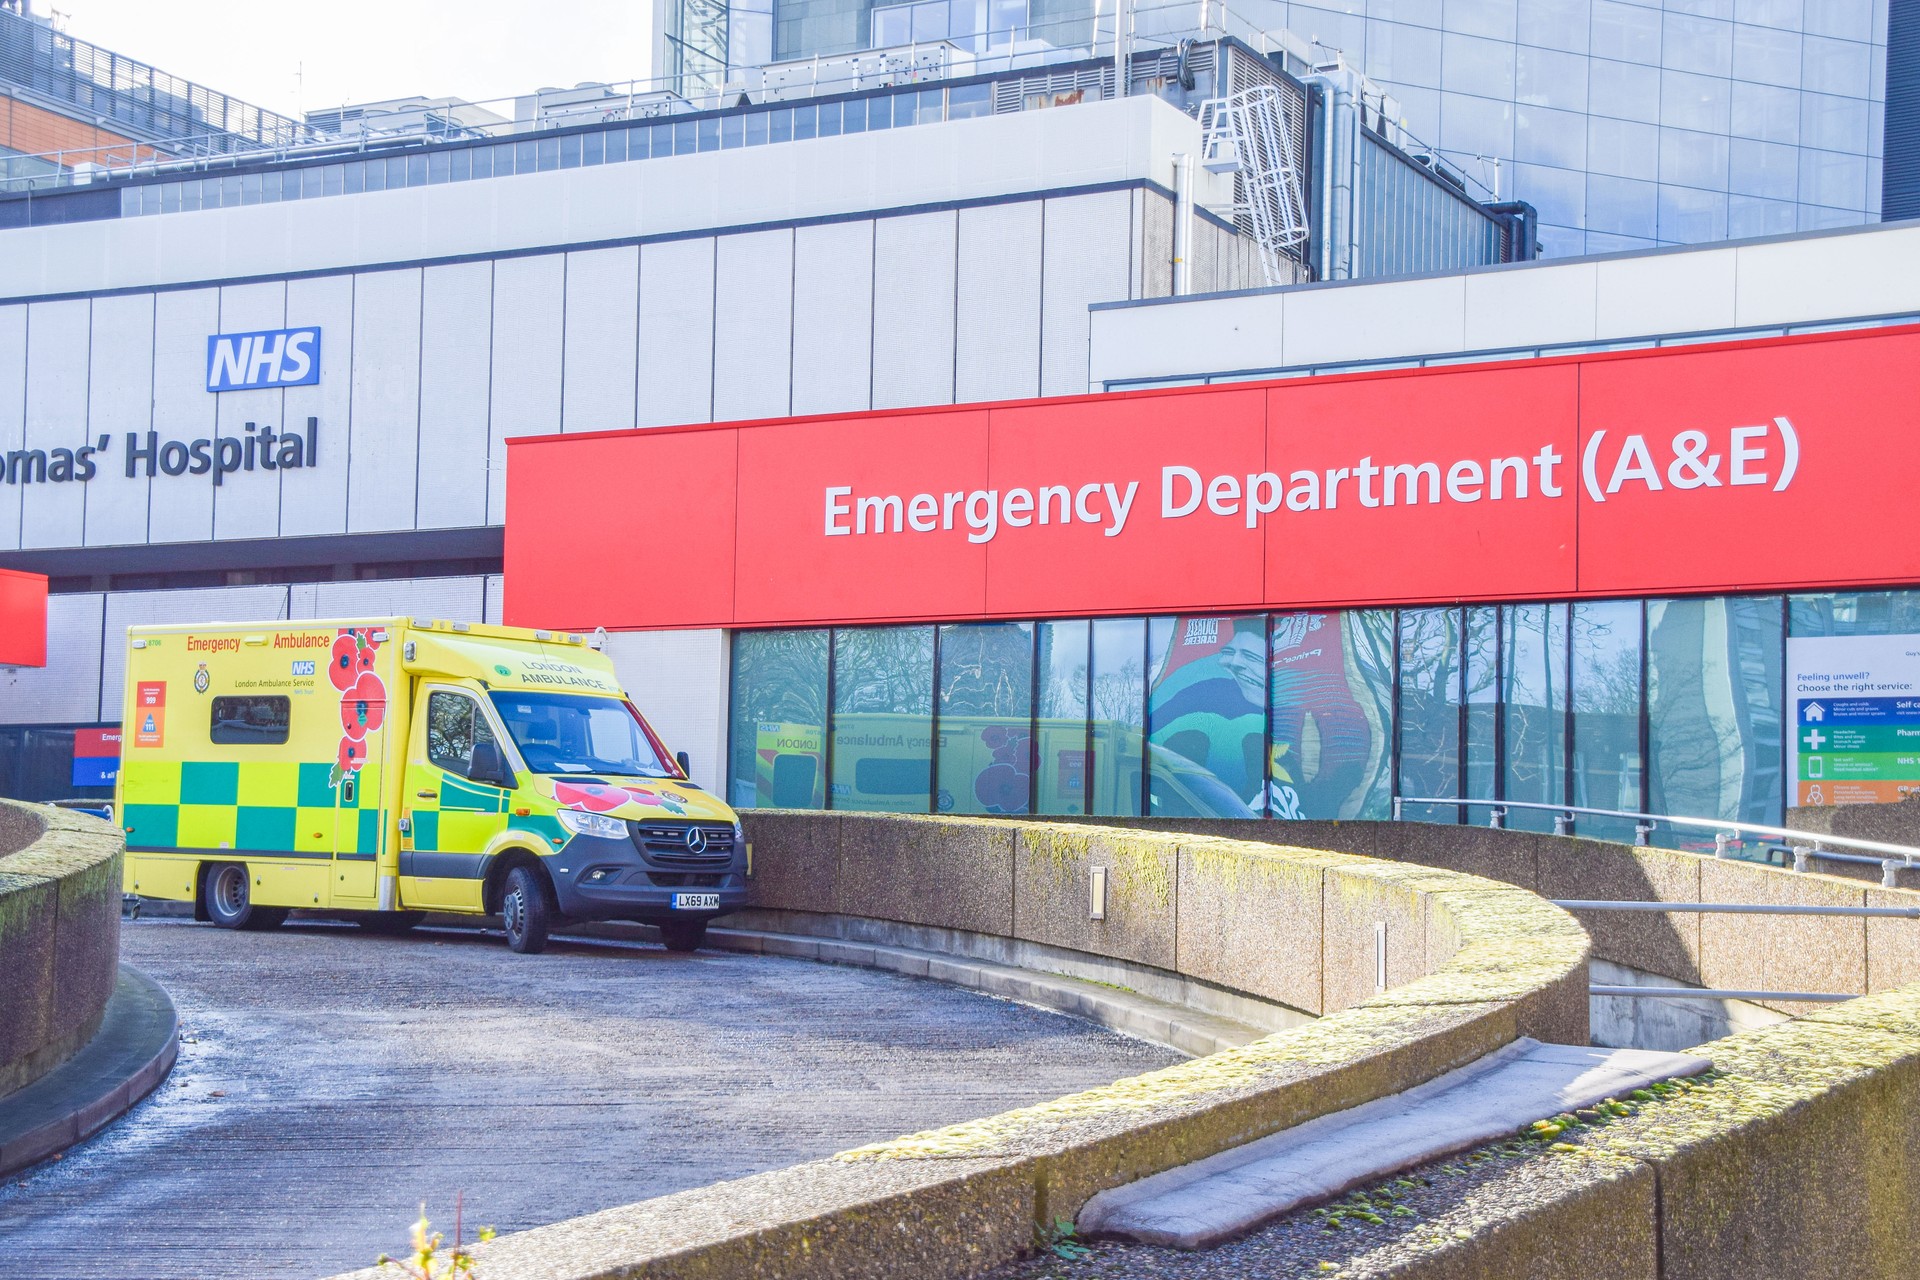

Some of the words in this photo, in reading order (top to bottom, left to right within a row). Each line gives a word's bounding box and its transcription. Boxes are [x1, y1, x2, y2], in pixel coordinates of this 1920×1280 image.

[209, 332, 315, 387] NHS
[0, 434, 110, 484] mas'
[126, 416, 318, 486] Hospital
[824, 481, 1139, 543] Emergency
[1161, 444, 1563, 529] Department
[1582, 416, 1800, 502] (A&E)
[187, 635, 241, 653] Emergency
[273, 632, 330, 649] Ambulance
[292, 661, 315, 675] NHS
[521, 661, 583, 674] LONDON
[234, 679, 257, 688] London
[258, 679, 291, 688] Ambulance
[293, 678, 314, 687] Service
[521, 674, 606, 689] AMBULANCE
[1797, 673, 1830, 683] Feeling
[1833, 671, 1870, 681] unwell?
[1797, 684, 1831, 692] Choose
[1833, 683, 1849, 692] the
[1852, 682, 1875, 693] right
[1877, 681, 1912, 691] service:
[146, 696, 157, 704] 999
[1896, 701, 1912, 709] Self
[145, 723, 154, 731] 111
[1897, 757, 1914, 765] NHS
[101, 771, 106, 779] &
[679, 895, 702, 907] LX69
[703, 895, 719, 907] AXM
